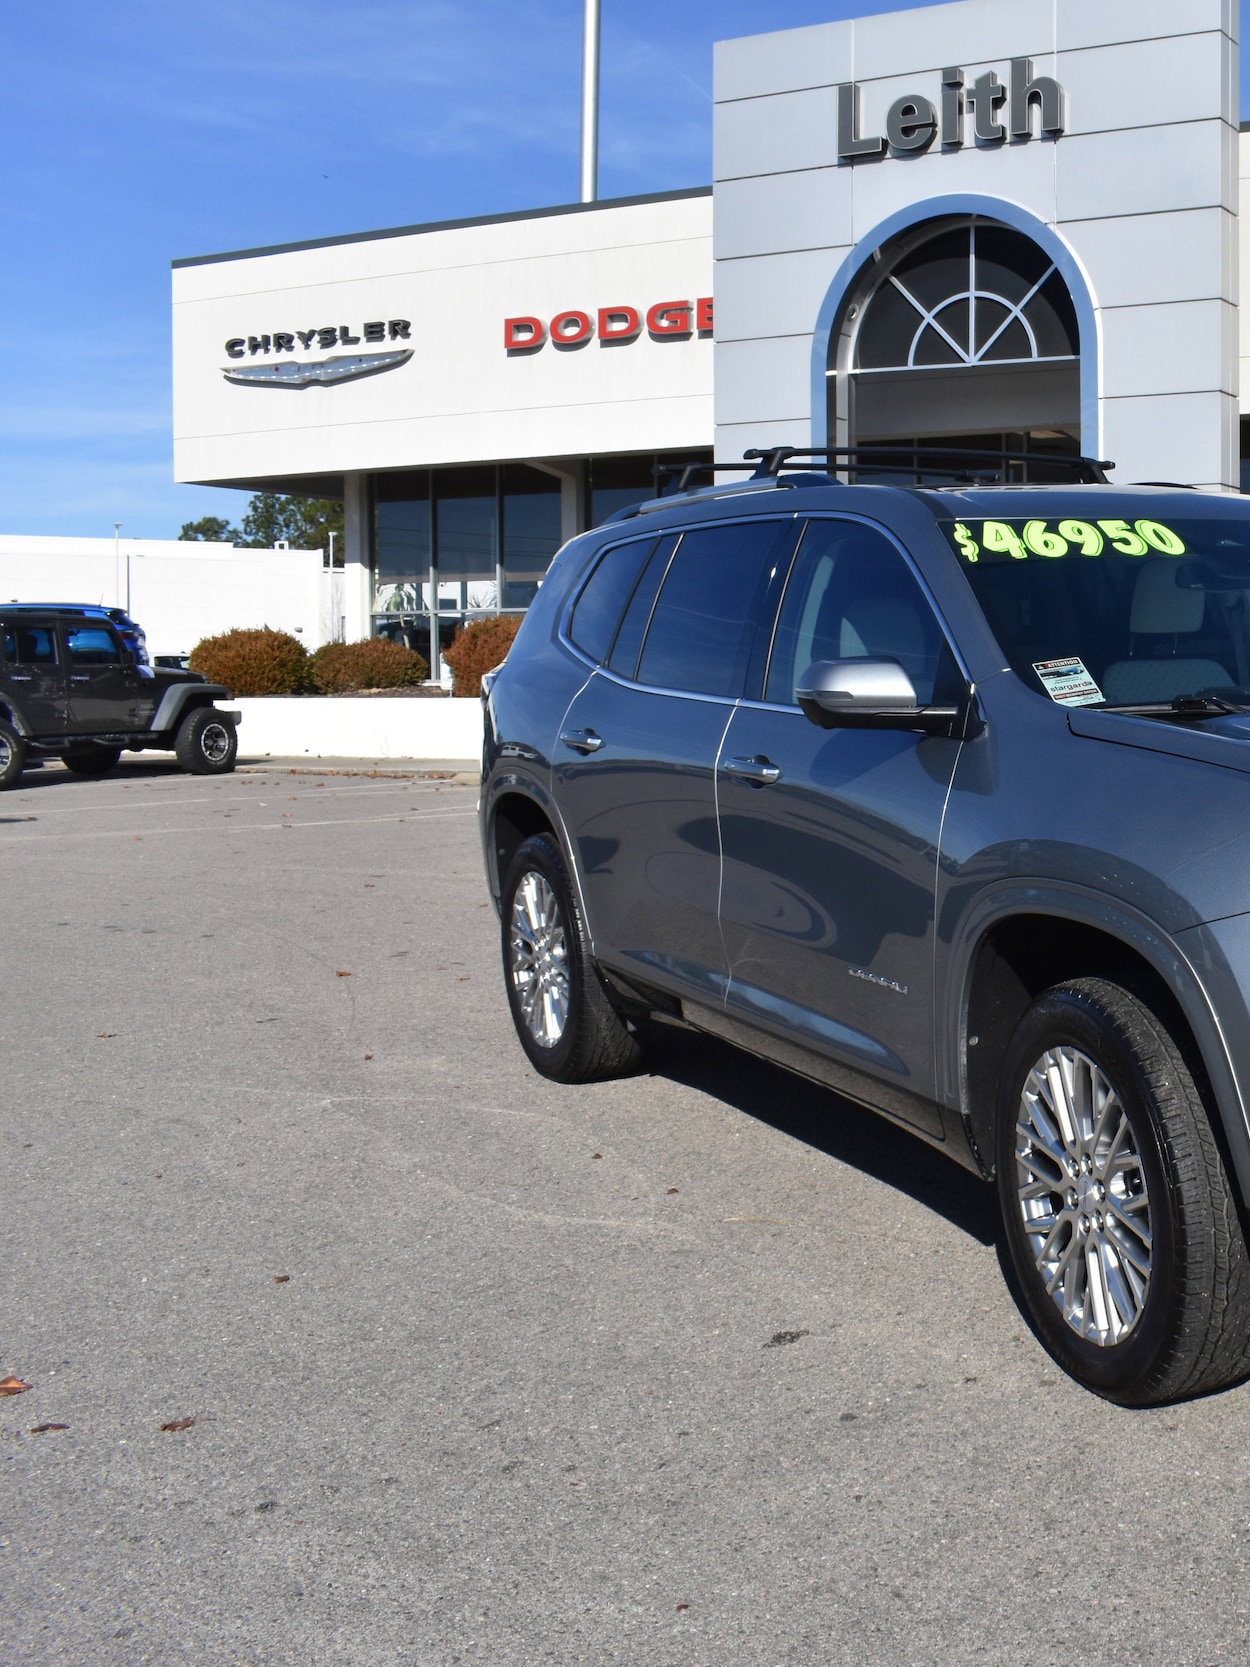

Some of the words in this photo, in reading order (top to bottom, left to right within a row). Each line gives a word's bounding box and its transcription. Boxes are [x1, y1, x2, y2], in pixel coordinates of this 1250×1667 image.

[838, 57, 1064, 159] Leith
[225, 319, 412, 358] CHRYSLER
[954, 519, 1186, 562] $46950
